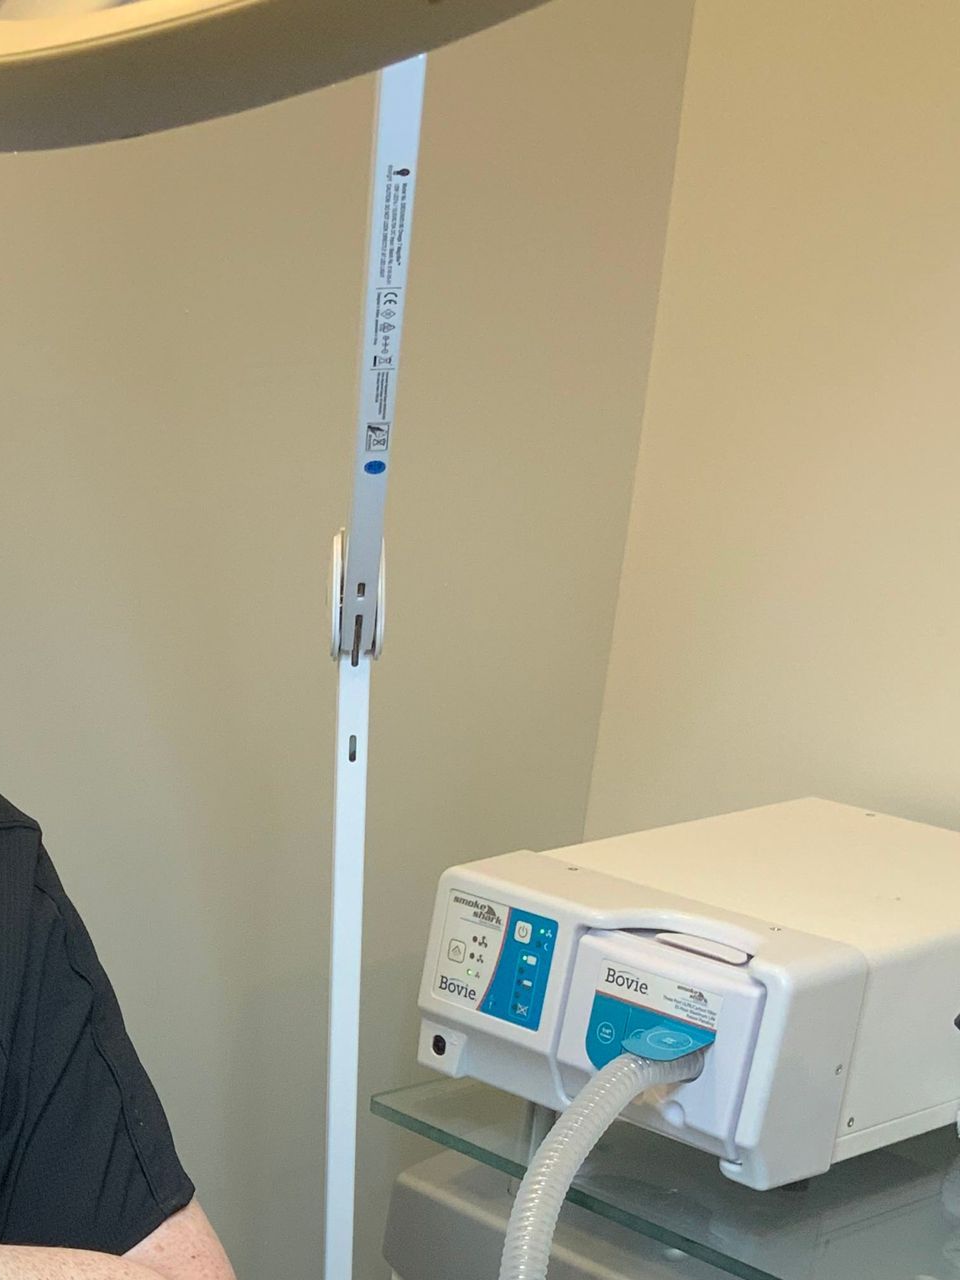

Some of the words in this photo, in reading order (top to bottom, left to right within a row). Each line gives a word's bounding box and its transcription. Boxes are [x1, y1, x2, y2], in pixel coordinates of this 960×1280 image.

[454, 895, 486, 911] smoke
[472, 910, 503, 925] shark
[439, 974, 476, 1001] Bovie
[605, 967, 648, 995] Bovie
